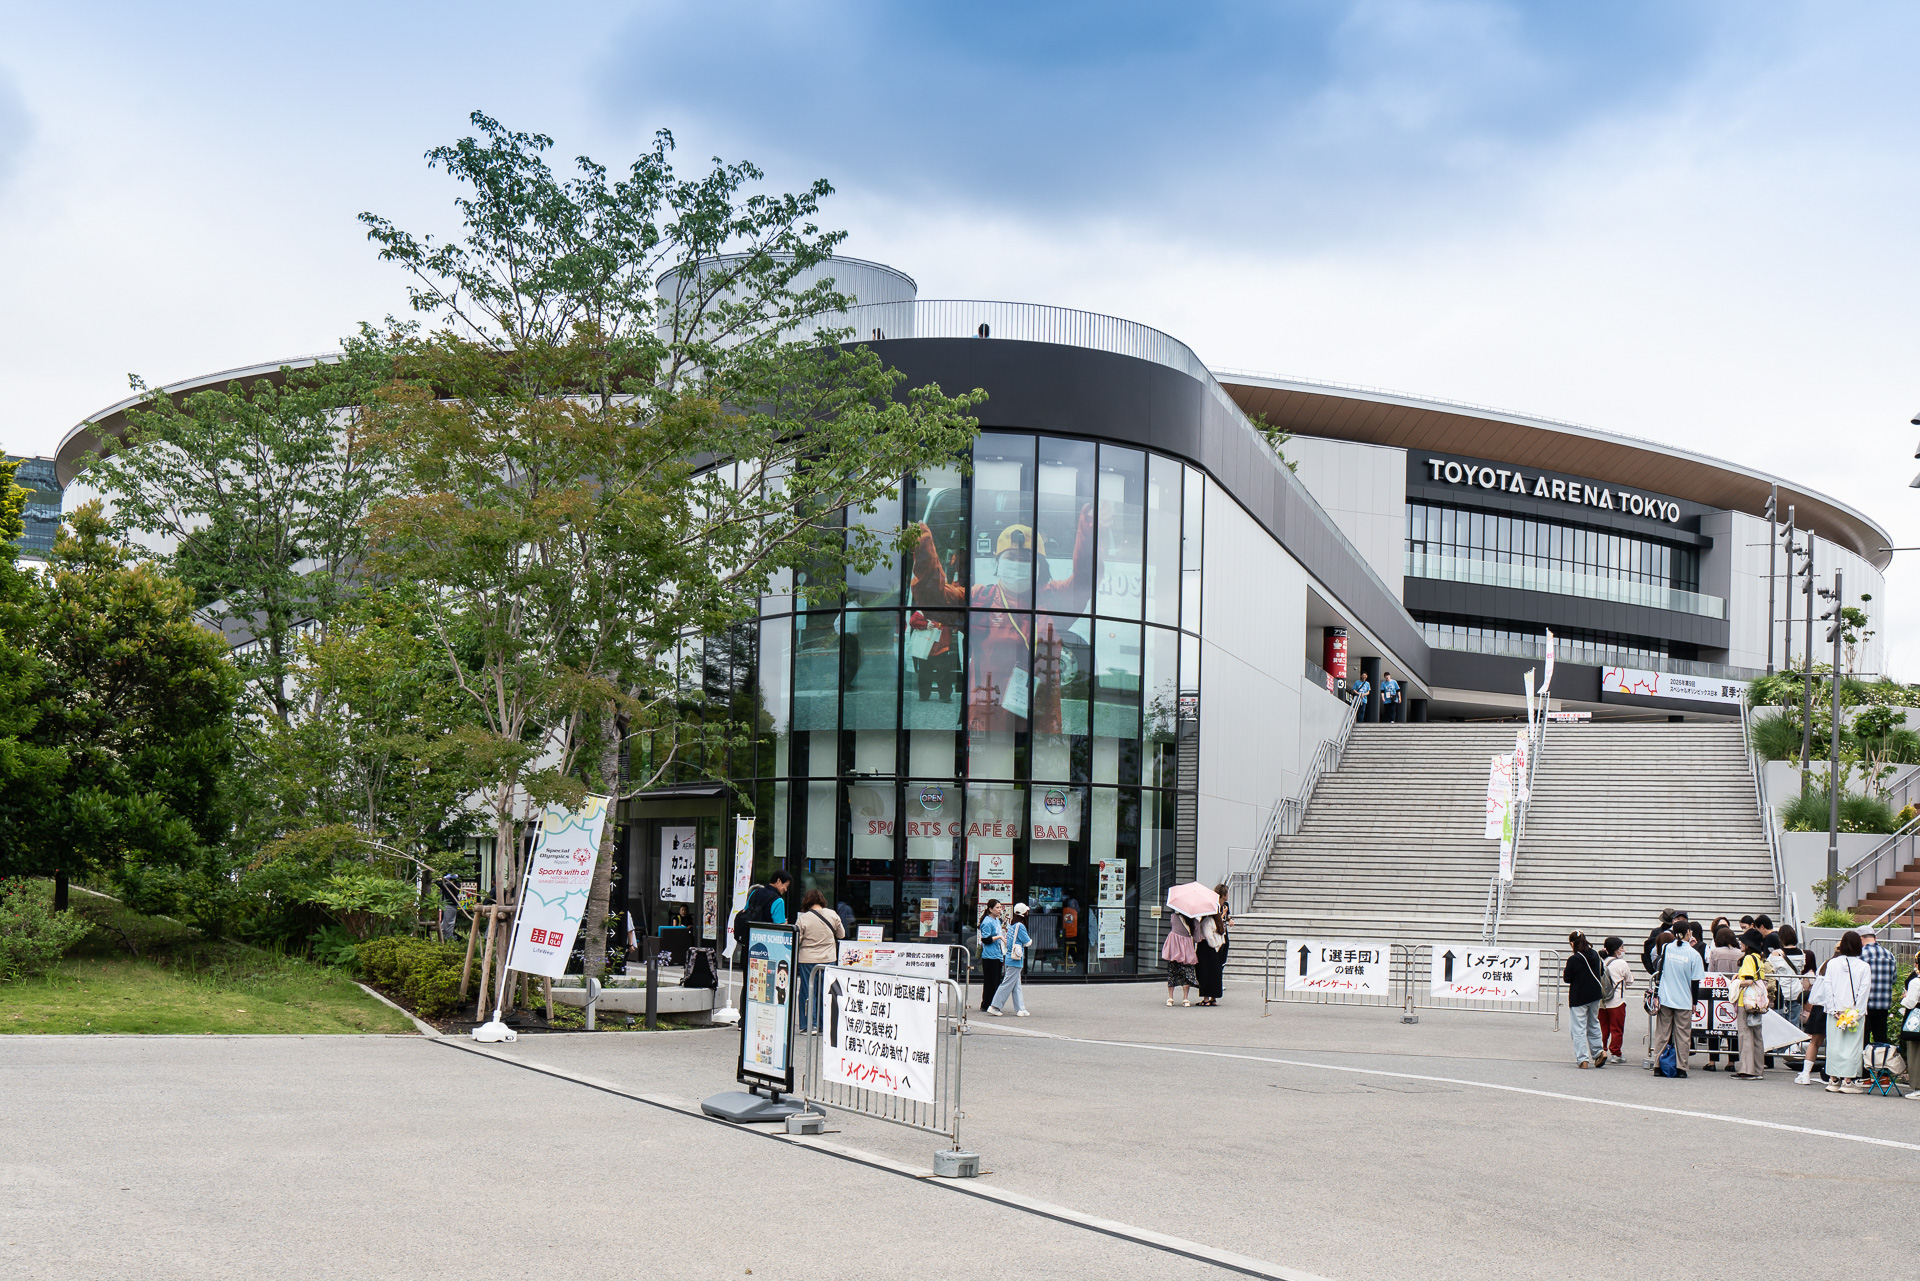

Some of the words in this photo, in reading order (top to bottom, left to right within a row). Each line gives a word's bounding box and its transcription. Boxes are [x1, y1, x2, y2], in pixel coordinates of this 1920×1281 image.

[1428, 458, 1526, 494] TOYOTA
[1533, 476, 1614, 510] ARENA
[1618, 491, 1680, 523] TOKYO
[922, 794, 942, 802] OPEN
[1046, 797, 1066, 806] OPEN
[1034, 824, 1069, 840] BAR
[538, 868, 562, 876] Sports
[564, 868, 578, 876] with
[568, 876, 590, 884] 2026
[751, 933, 766, 943] EVENT
[767, 935, 793, 946] SCHEDULE
[532, 947, 554, 956] LifeWear
[1321, 948, 1380, 964] 【選手団】
[1466, 953, 1530, 970] 【メディア】
[1335, 966, 1365, 975] の皆様
[1482, 972, 1513, 982] の皆様
[1699, 976, 1727, 988] 荷物
